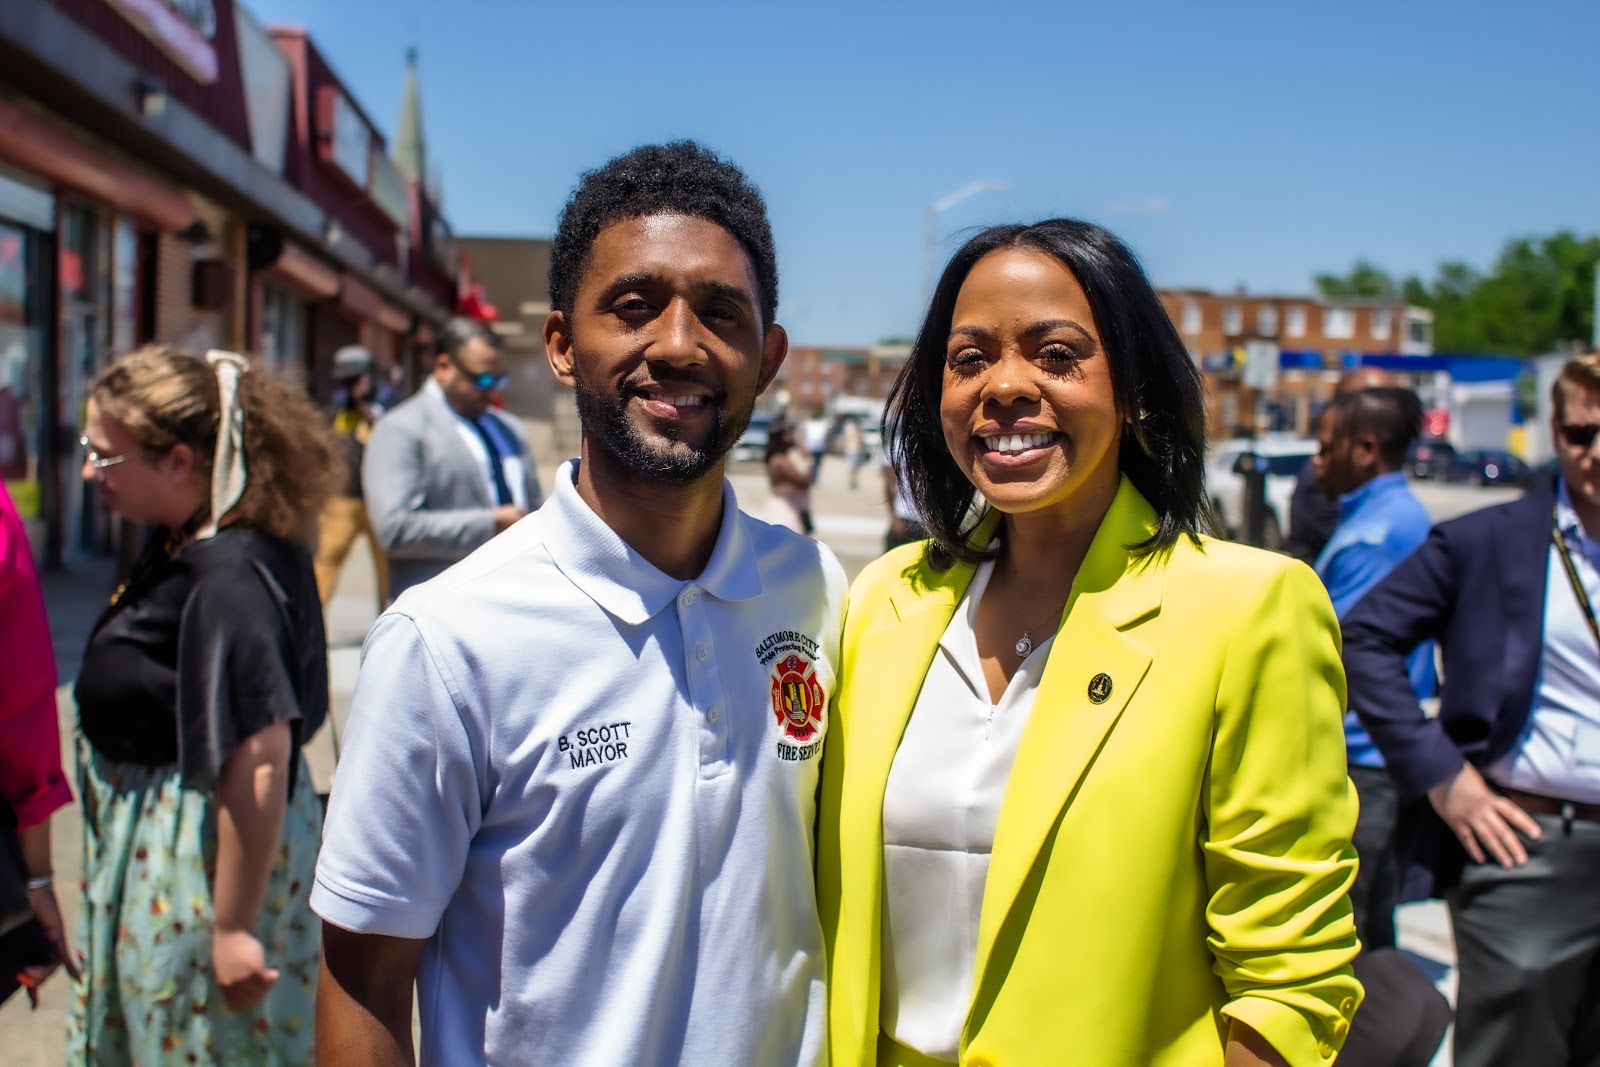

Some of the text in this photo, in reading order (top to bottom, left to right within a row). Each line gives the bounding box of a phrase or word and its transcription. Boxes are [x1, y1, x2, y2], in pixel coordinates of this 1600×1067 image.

[755, 631, 820, 658] BALTIMORE CITY
[558, 722, 631, 752] B. SCOTT
[569, 742, 628, 769] MAYOR
[777, 742, 798, 761] FIRE
